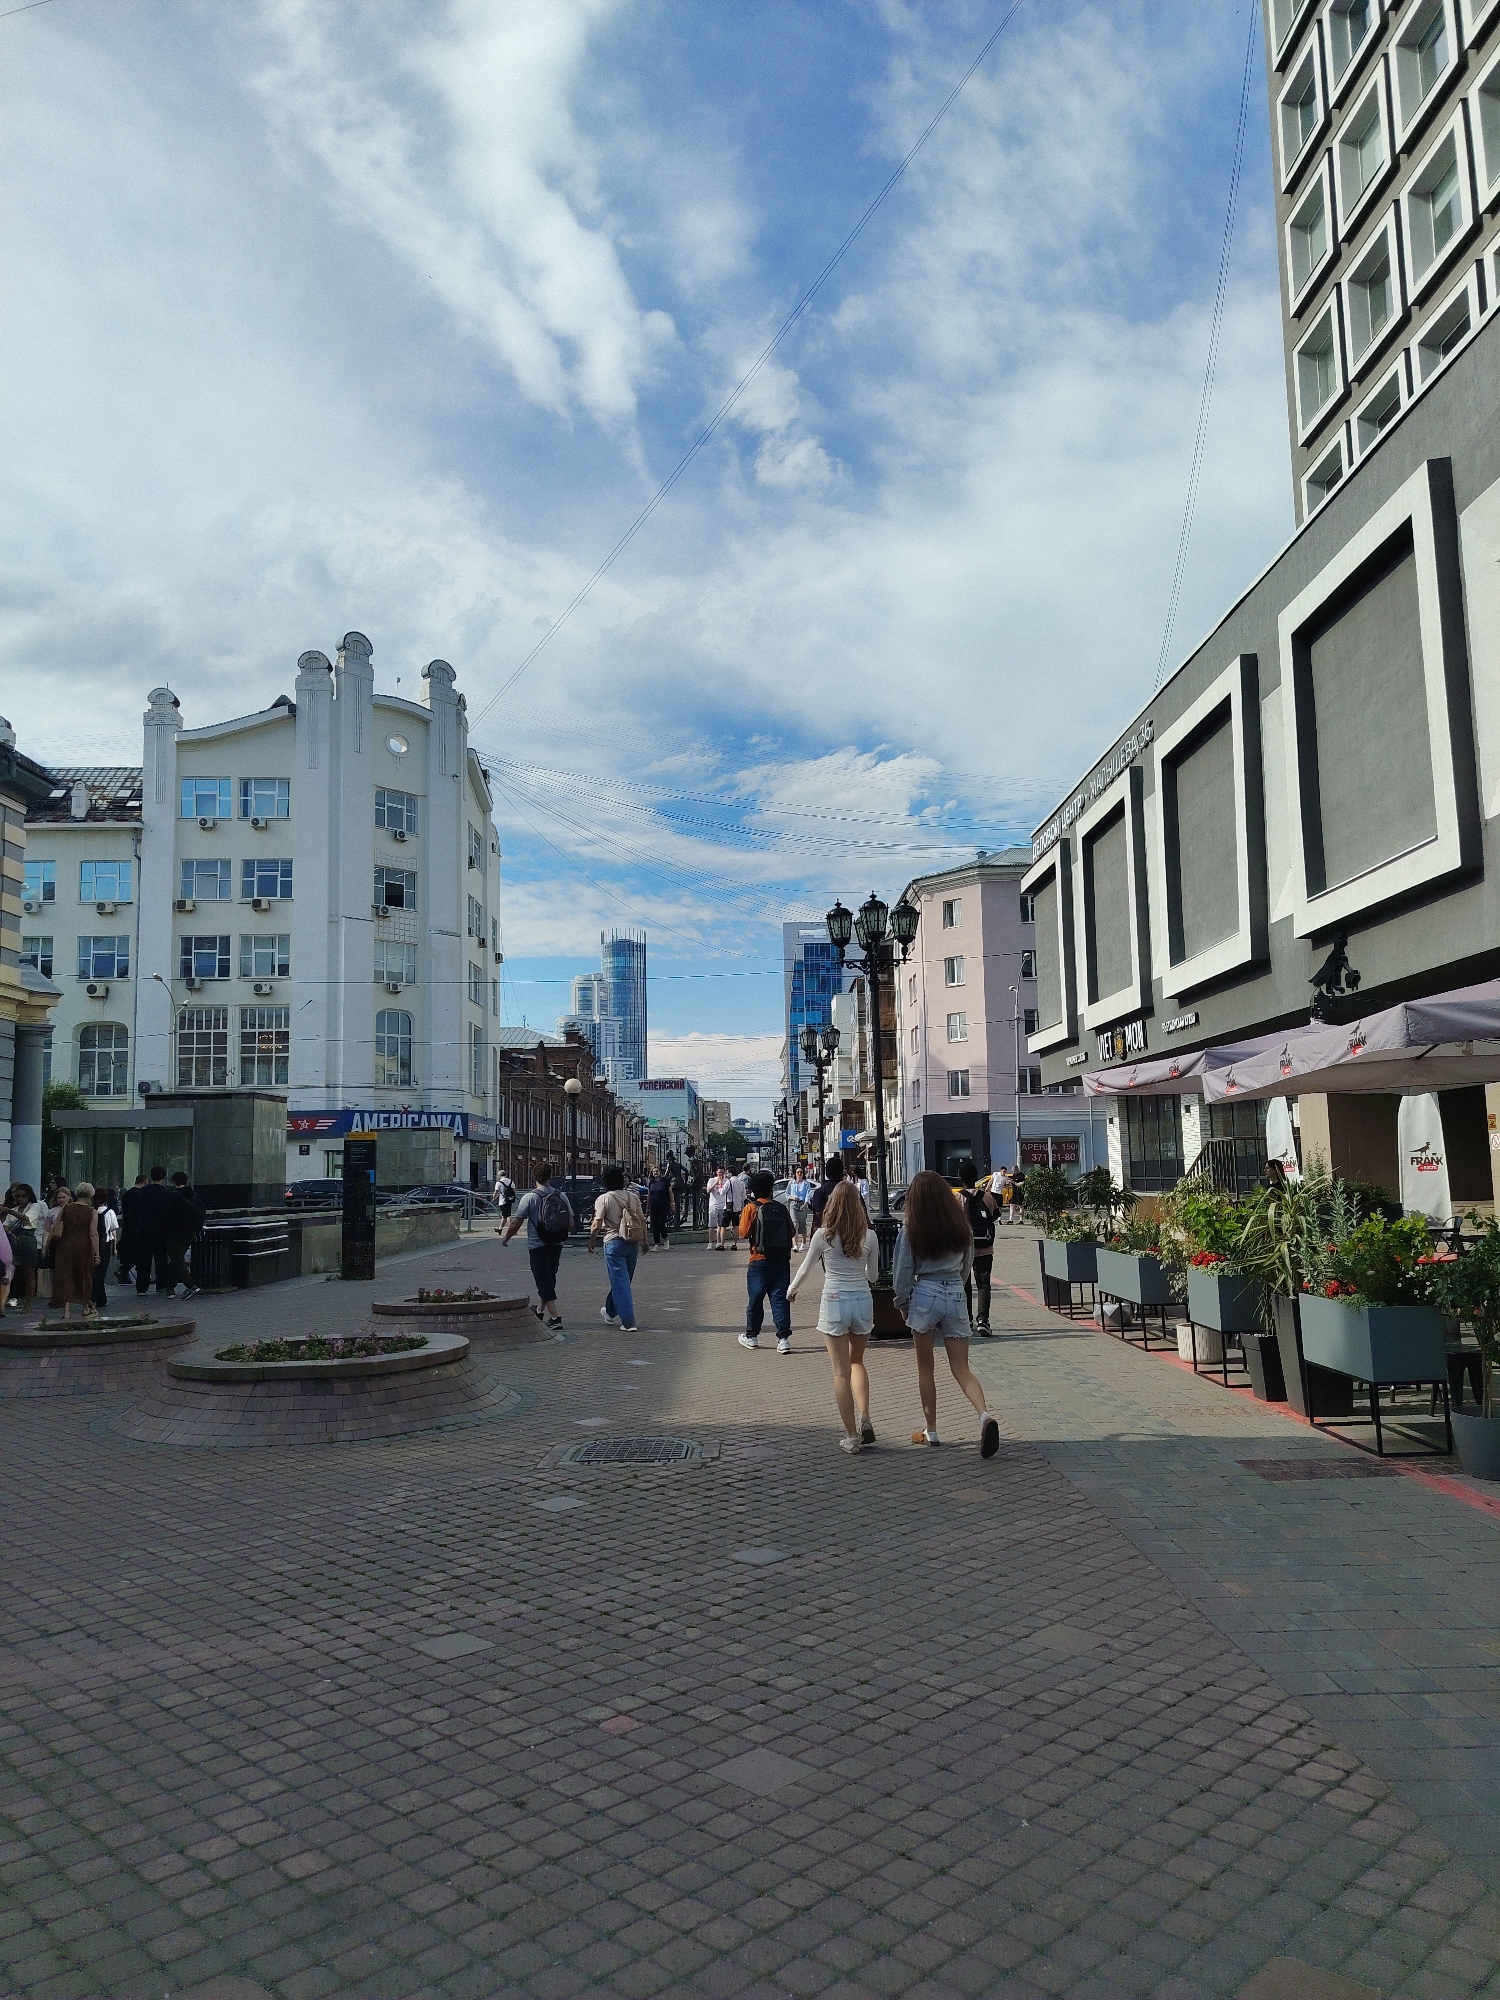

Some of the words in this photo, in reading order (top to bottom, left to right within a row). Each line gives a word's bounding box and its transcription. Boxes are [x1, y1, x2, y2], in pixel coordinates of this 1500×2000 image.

[1060, 792, 1085, 832] ЦЕНТР
[638, 1079, 685, 1091] УСПЕНСКИЙ
[351, 1113, 464, 1136] AMERICANKA
[1031, 1153, 1075, 1161] 37121-80
[1410, 1156, 1444, 1166] FRANK
